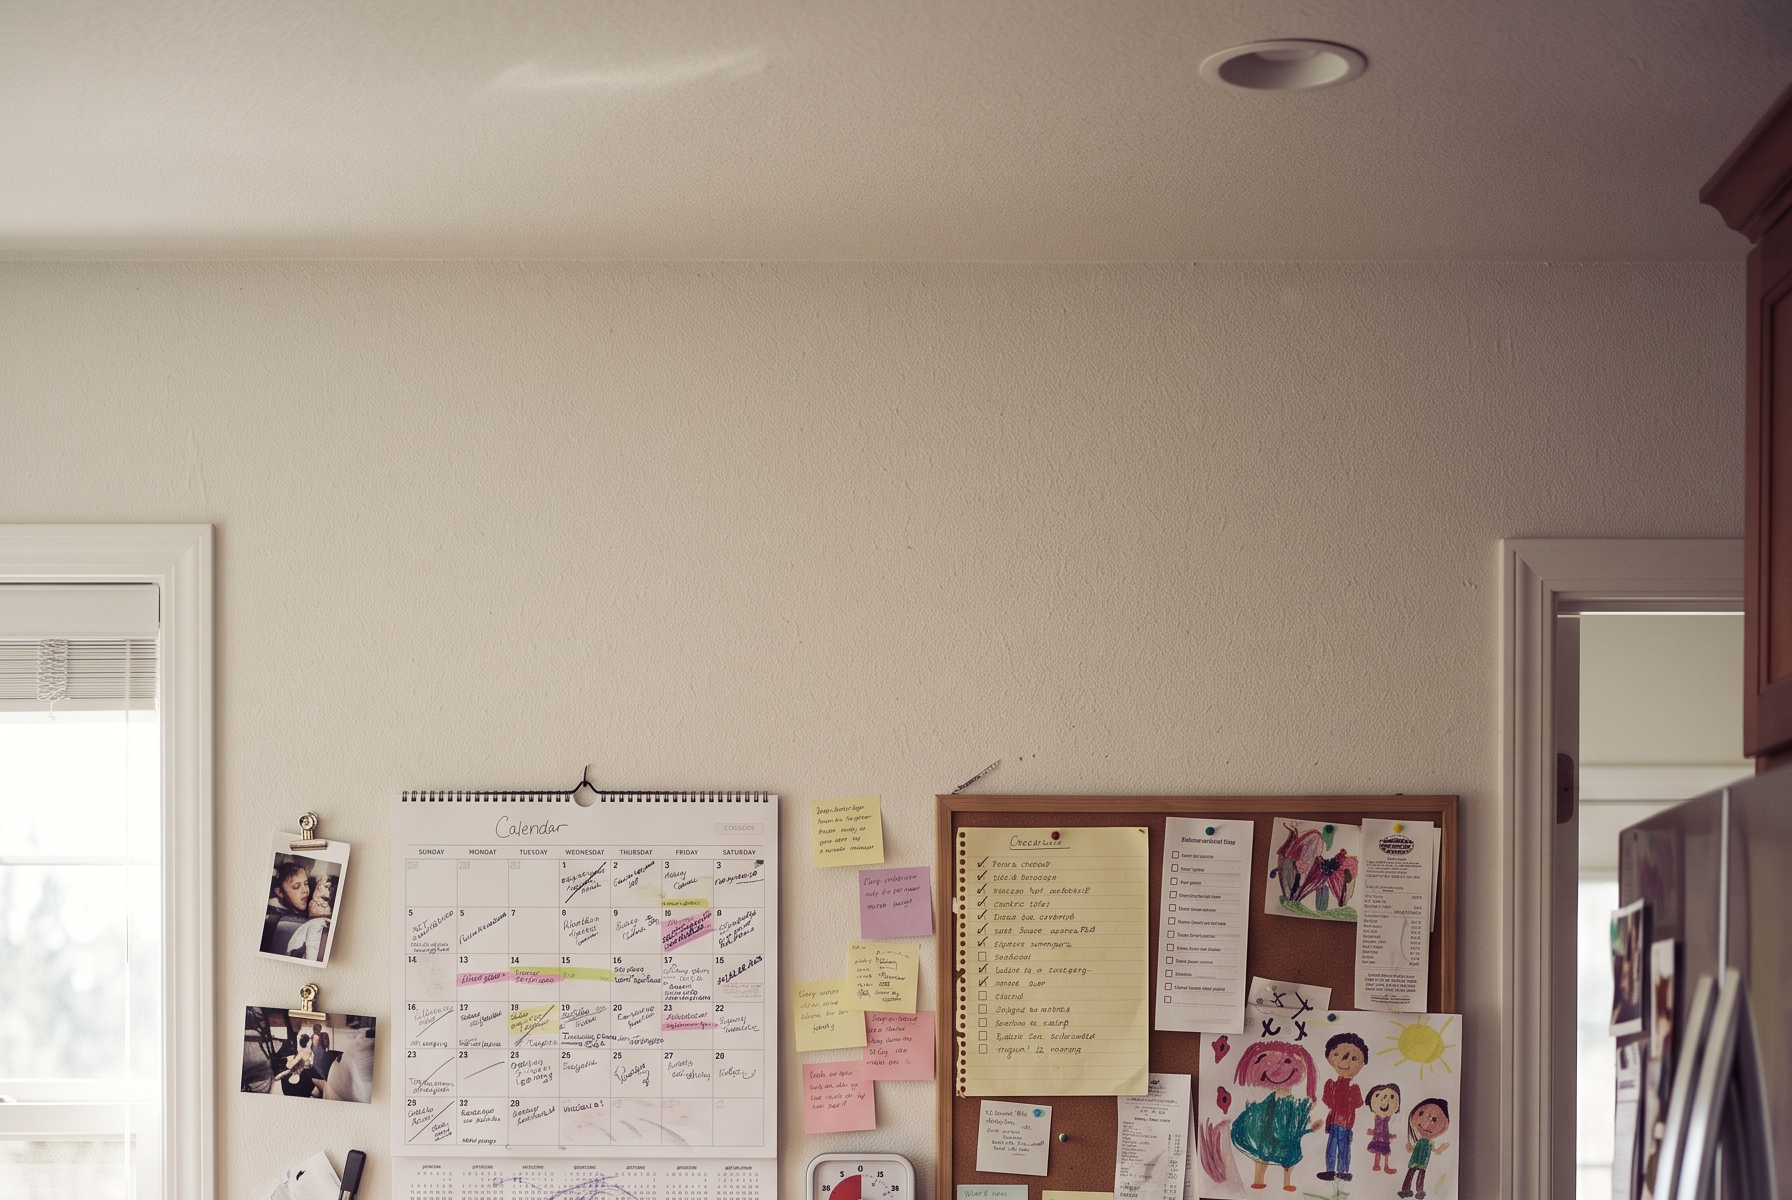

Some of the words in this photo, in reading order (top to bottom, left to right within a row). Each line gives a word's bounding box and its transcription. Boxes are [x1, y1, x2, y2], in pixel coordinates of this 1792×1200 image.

[495, 815, 568, 839] Calendar
[675, 848, 699, 858] FRIDAY
[722, 848, 757, 858] SATURDAY
[562, 861, 566, 869] 1
[613, 861, 618, 869] 2
[664, 861, 670, 869] 3
[716, 861, 722, 870] 3
[408, 909, 414, 917] 5
[510, 909, 516, 917] 7
[459, 955, 469, 964] 13
[510, 956, 520, 964] 14
[561, 956, 571, 964] 15
[613, 956, 622, 964] 16
[714, 1004, 725, 1012] 22
[407, 1050, 417, 1059] 23
[612, 1051, 623, 1060] 25
[664, 1052, 674, 1060] 27
